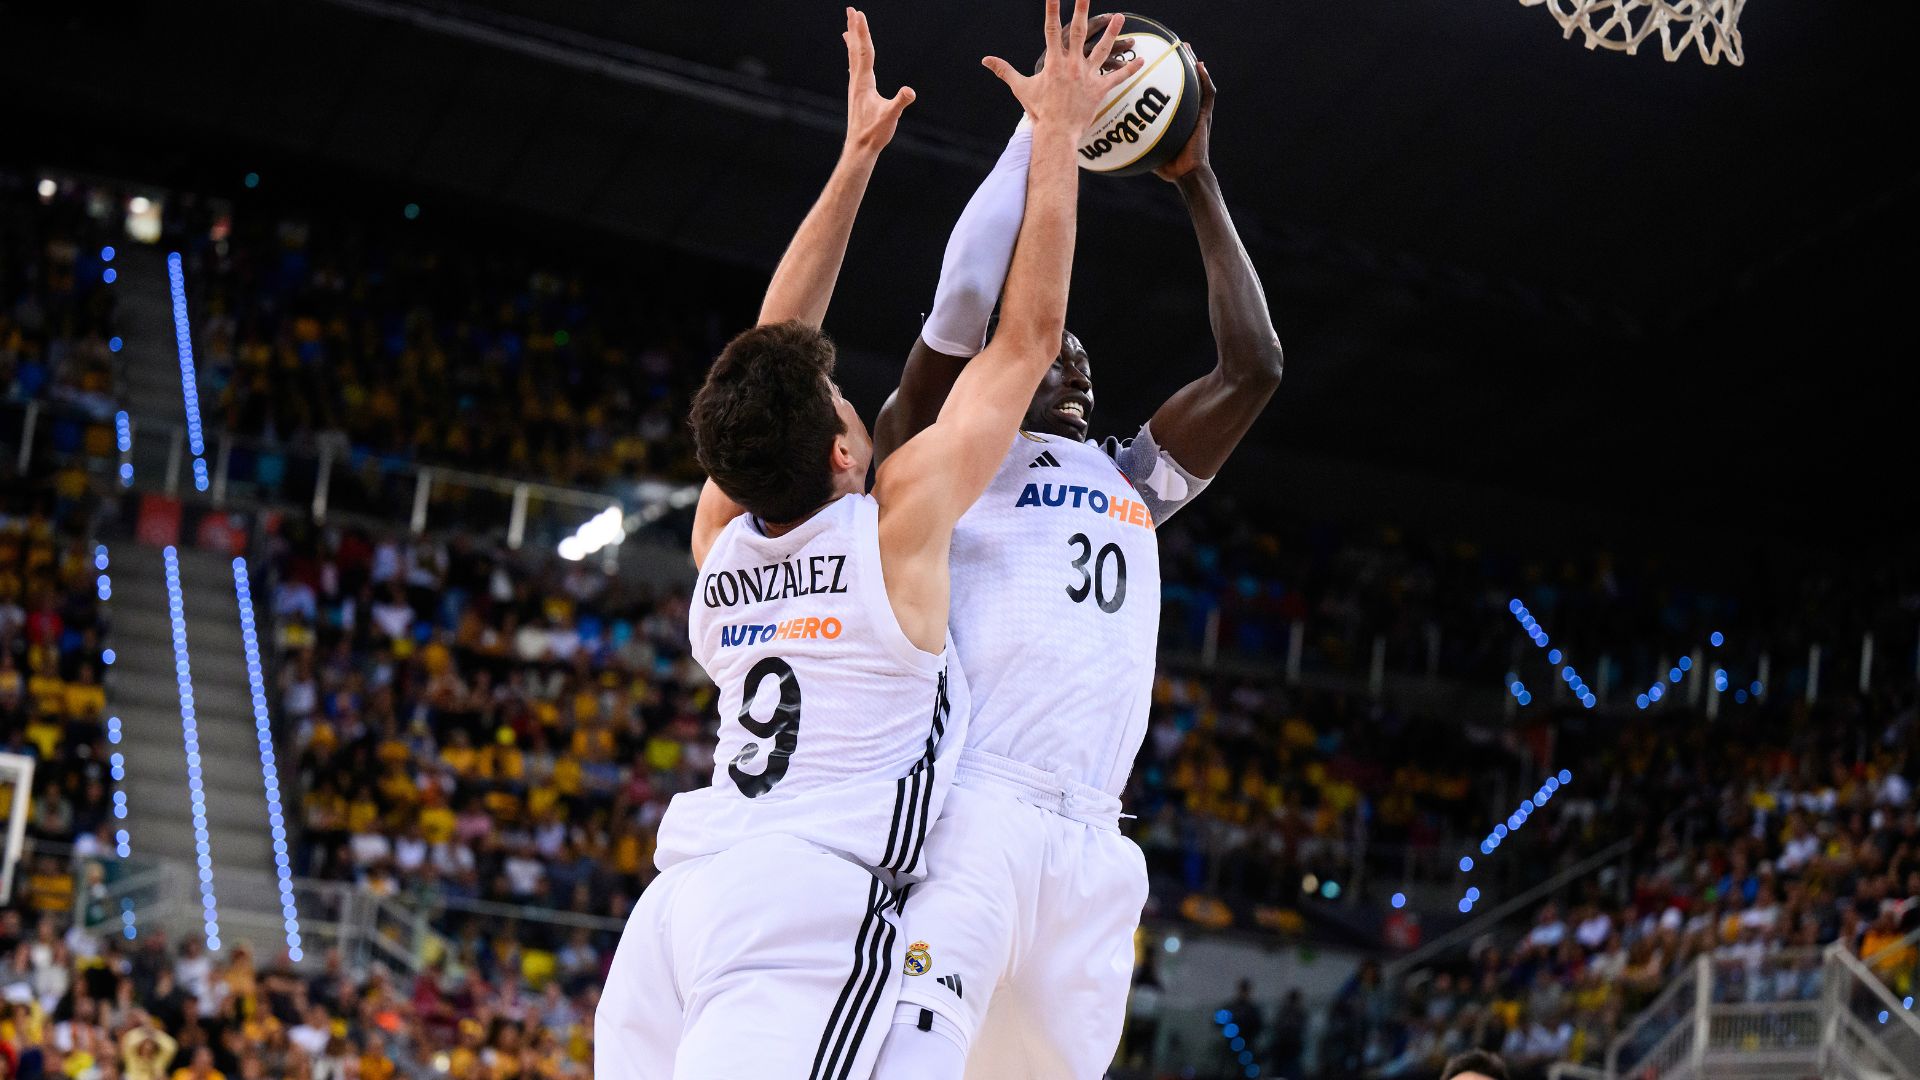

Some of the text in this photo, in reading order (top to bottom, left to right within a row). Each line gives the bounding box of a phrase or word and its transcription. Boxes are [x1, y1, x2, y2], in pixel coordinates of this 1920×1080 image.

[1078, 87, 1171, 160] Wilson
[703, 554, 848, 609] GONZÁLEZ
[1065, 532, 1127, 614] 30
[721, 616, 842, 648] AUTOHERO
[728, 656, 802, 799] 9
